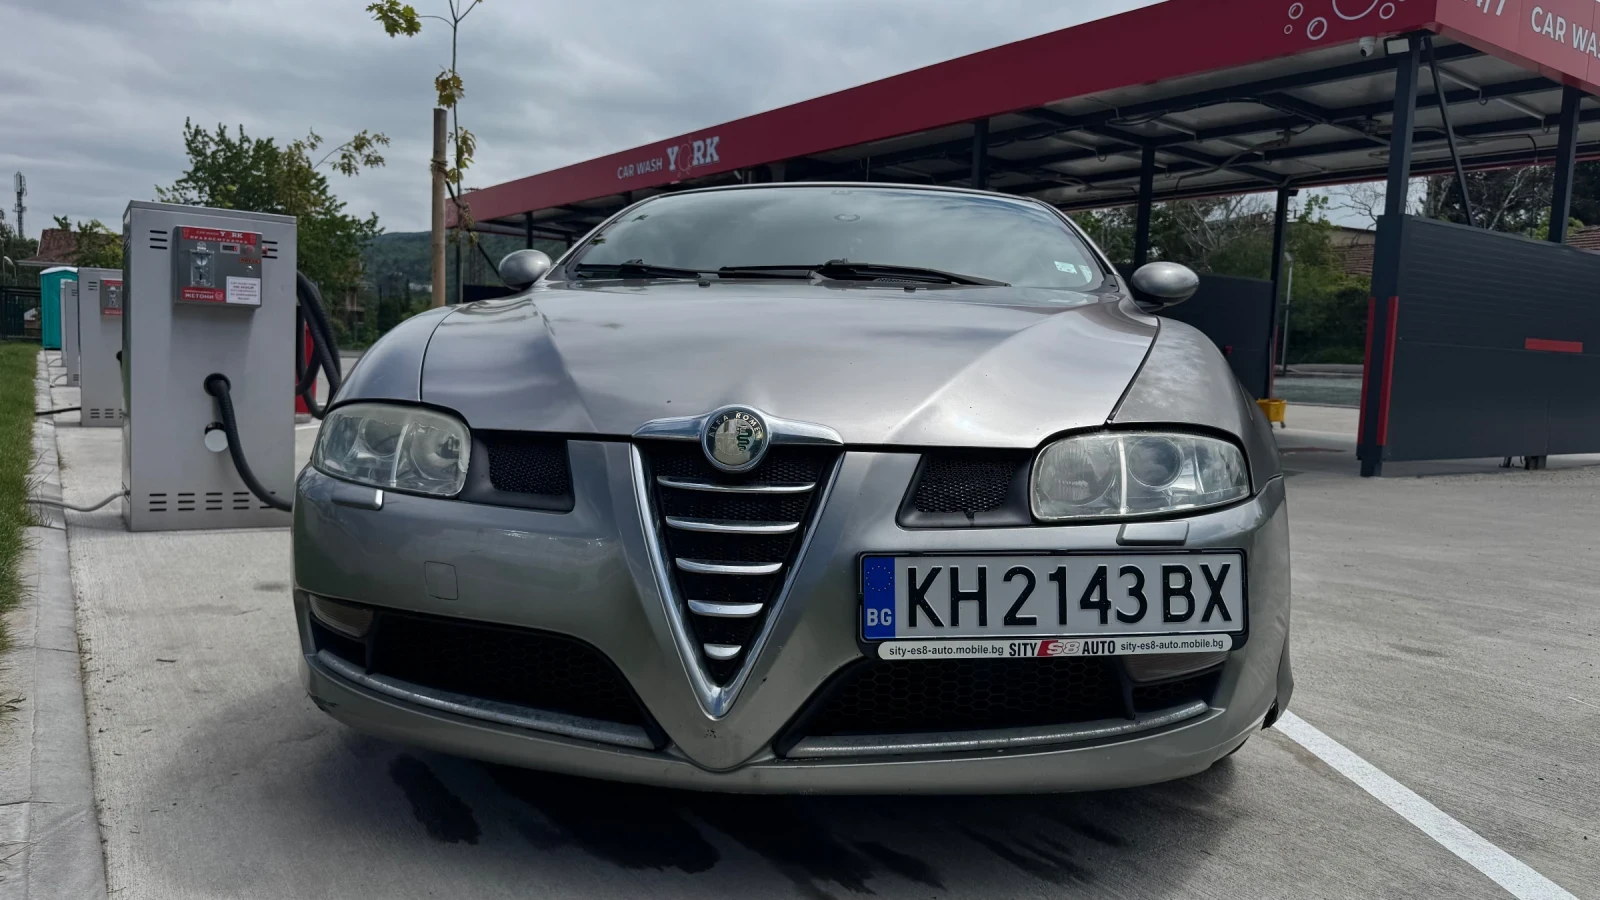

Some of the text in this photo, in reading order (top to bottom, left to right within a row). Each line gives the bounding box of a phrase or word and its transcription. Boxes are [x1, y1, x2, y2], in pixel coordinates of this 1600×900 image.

[1531, 6, 1566, 44] CAR
[1572, 23, 1600, 60] WA
[617, 164, 635, 179] CAR
[636, 157, 663, 175] WASH
[220, 231, 243, 239] YRK
[708, 415, 729, 438] ALFA
[866, 608, 892, 627] BG
[889, 644, 1004, 658] sity-es8-auto.mobile.bg
[1008, 642, 1038, 657] SITY
[1082, 640, 1116, 655] AUTO
[1120, 639, 1224, 653] sity-es8-auto.mobile.bg
